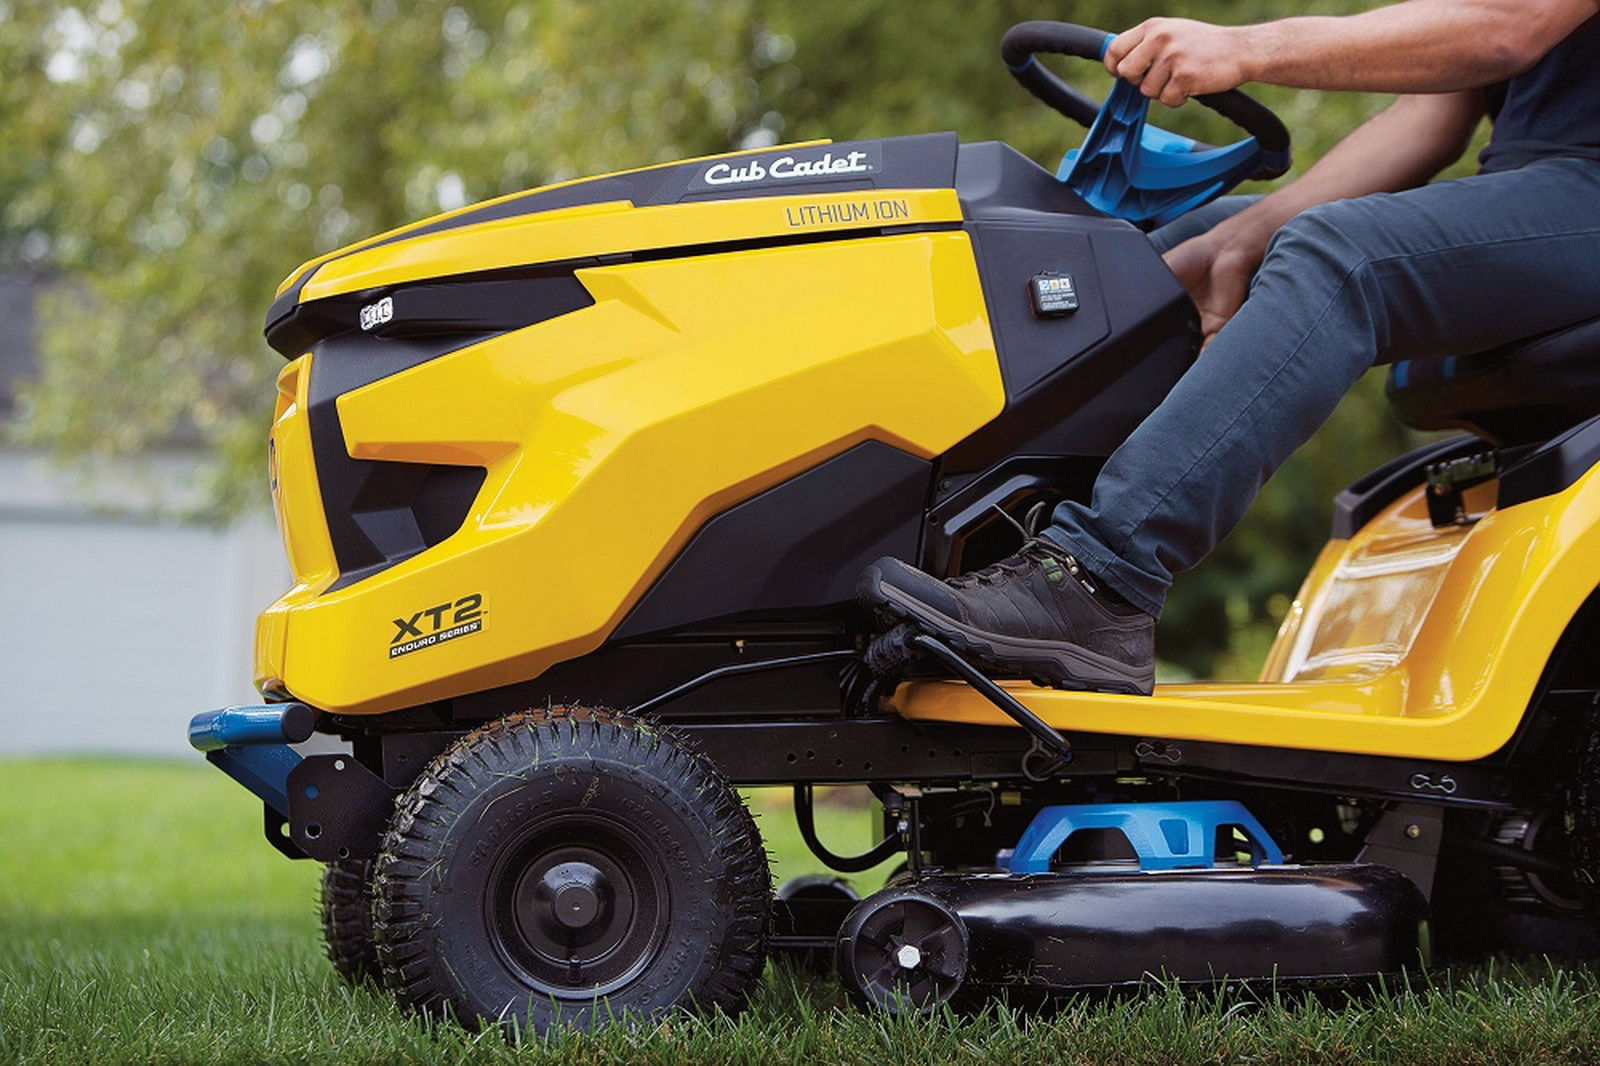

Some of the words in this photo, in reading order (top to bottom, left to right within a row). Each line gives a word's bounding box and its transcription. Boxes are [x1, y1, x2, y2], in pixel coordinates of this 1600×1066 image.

[704, 161, 766, 185] Cub
[786, 202, 870, 227] LITHIUM
[874, 200, 909, 219] ION
[390, 593, 483, 645] XT2
[390, 635, 436, 656] ENDURO
[439, 622, 479, 641] SERIES
